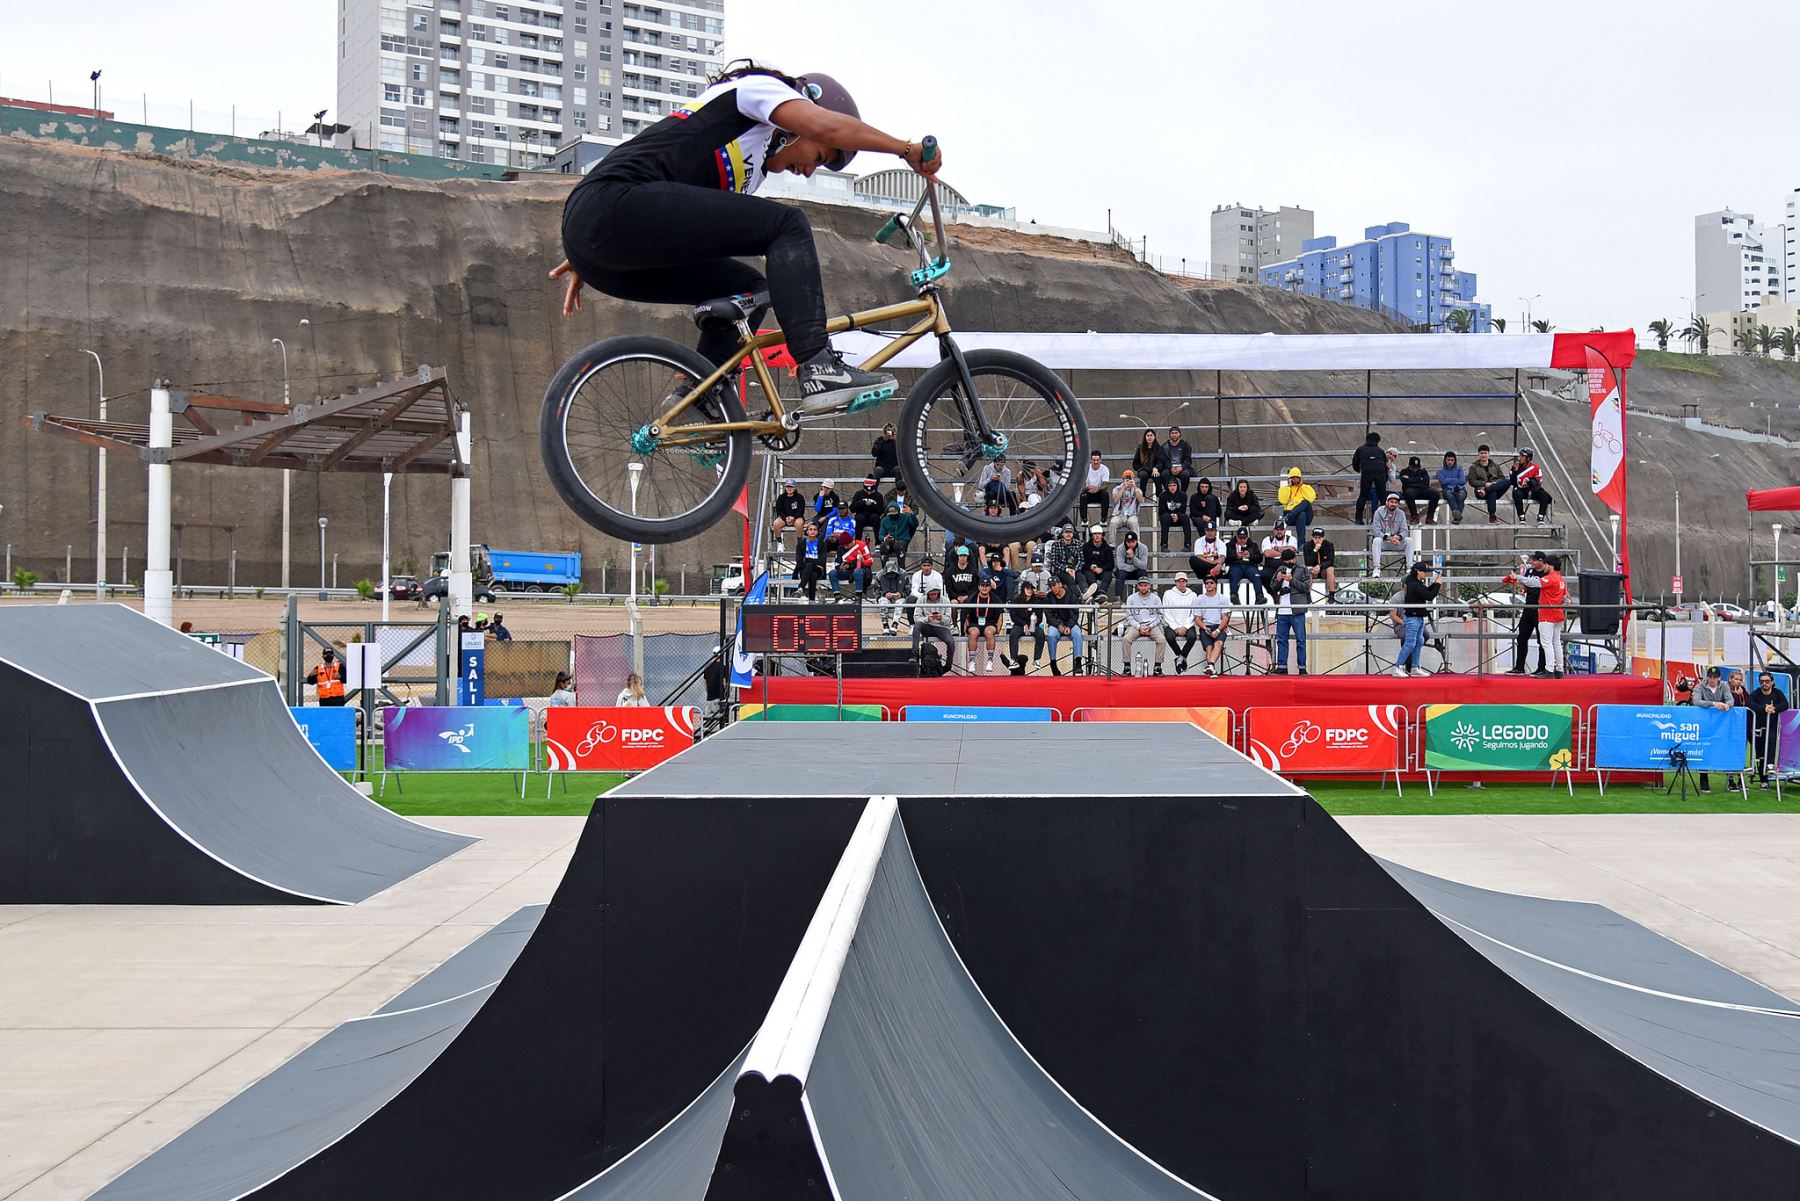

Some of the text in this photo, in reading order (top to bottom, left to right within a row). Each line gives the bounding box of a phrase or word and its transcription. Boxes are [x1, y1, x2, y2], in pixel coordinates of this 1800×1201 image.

[952, 573, 973, 582] VANS
[773, 616, 858, 652] 0:56
[1680, 723, 1700, 731] san
[448, 736, 464, 744] IPD
[622, 728, 664, 742] FDPC
[1326, 728, 1368, 742] FDPC
[1660, 729, 1700, 744] miguel
[1482, 741, 1548, 750] Seguimos jugando
